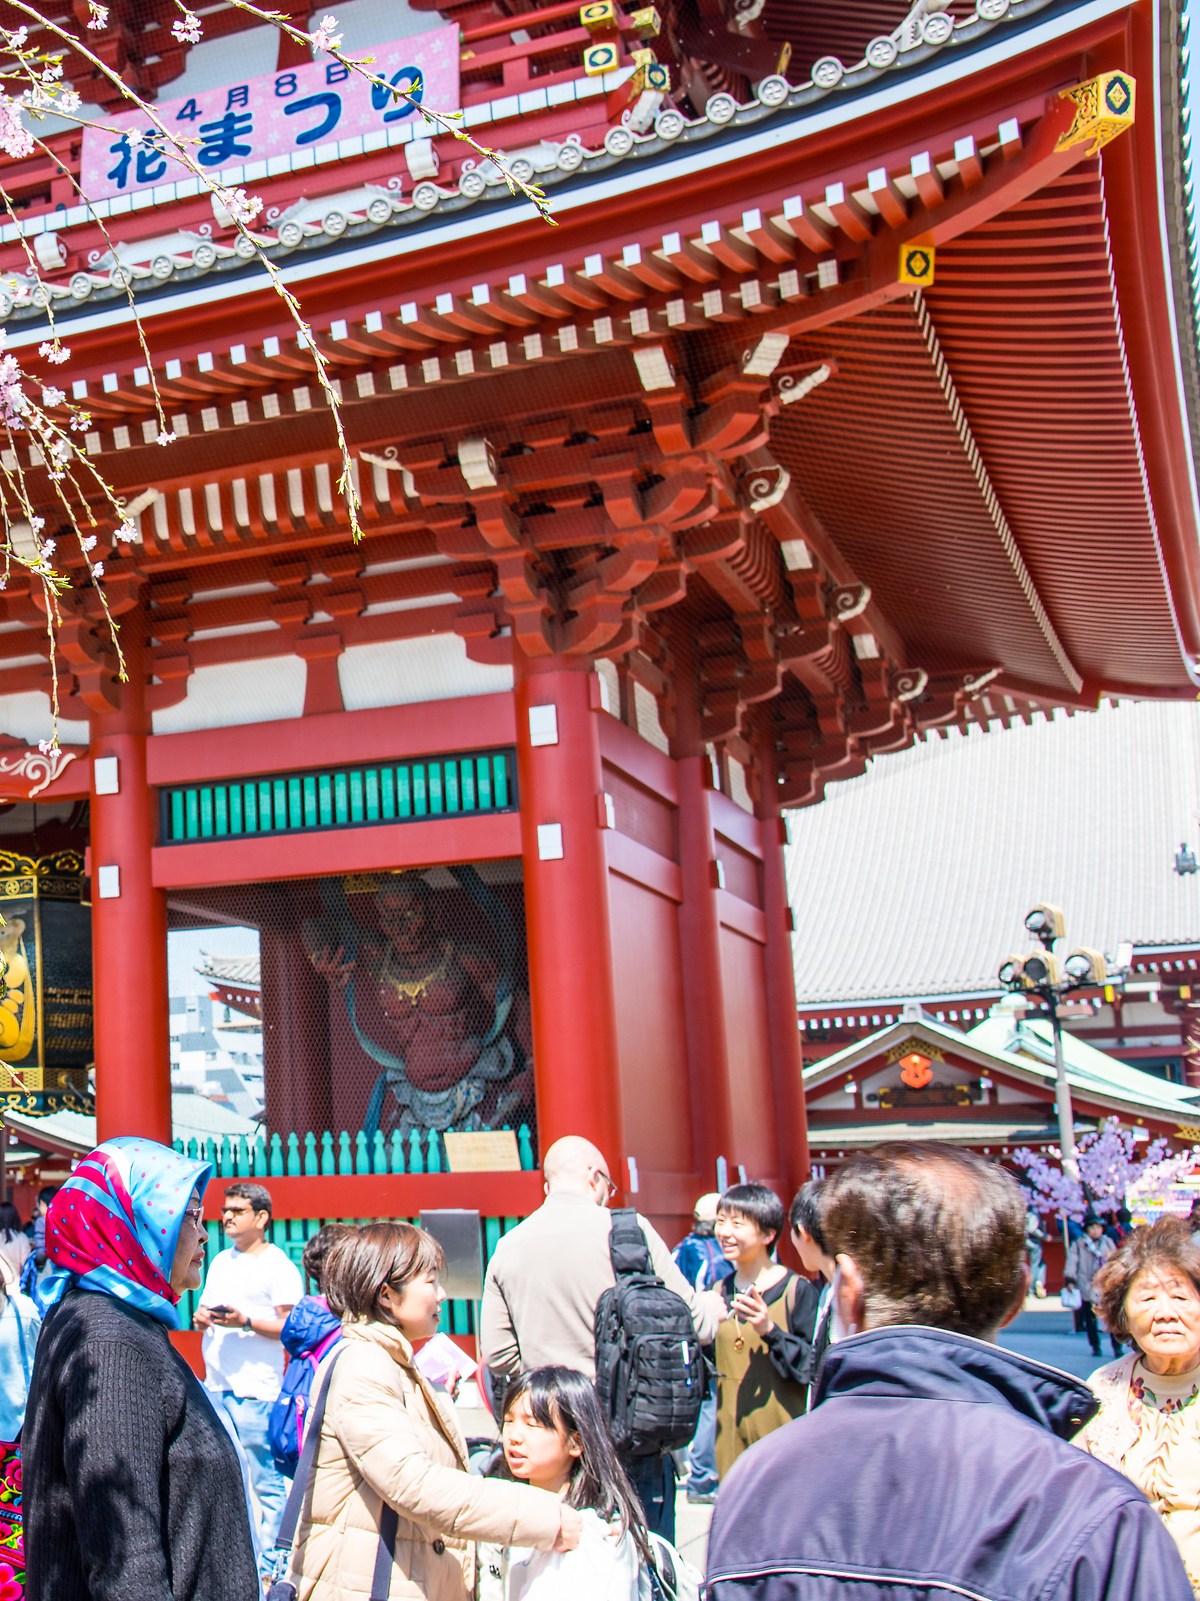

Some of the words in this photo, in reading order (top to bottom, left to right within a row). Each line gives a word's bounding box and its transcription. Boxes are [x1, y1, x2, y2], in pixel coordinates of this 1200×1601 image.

[107, 65, 424, 189] 花まつり
[176, 62, 349, 122] 4月8日
